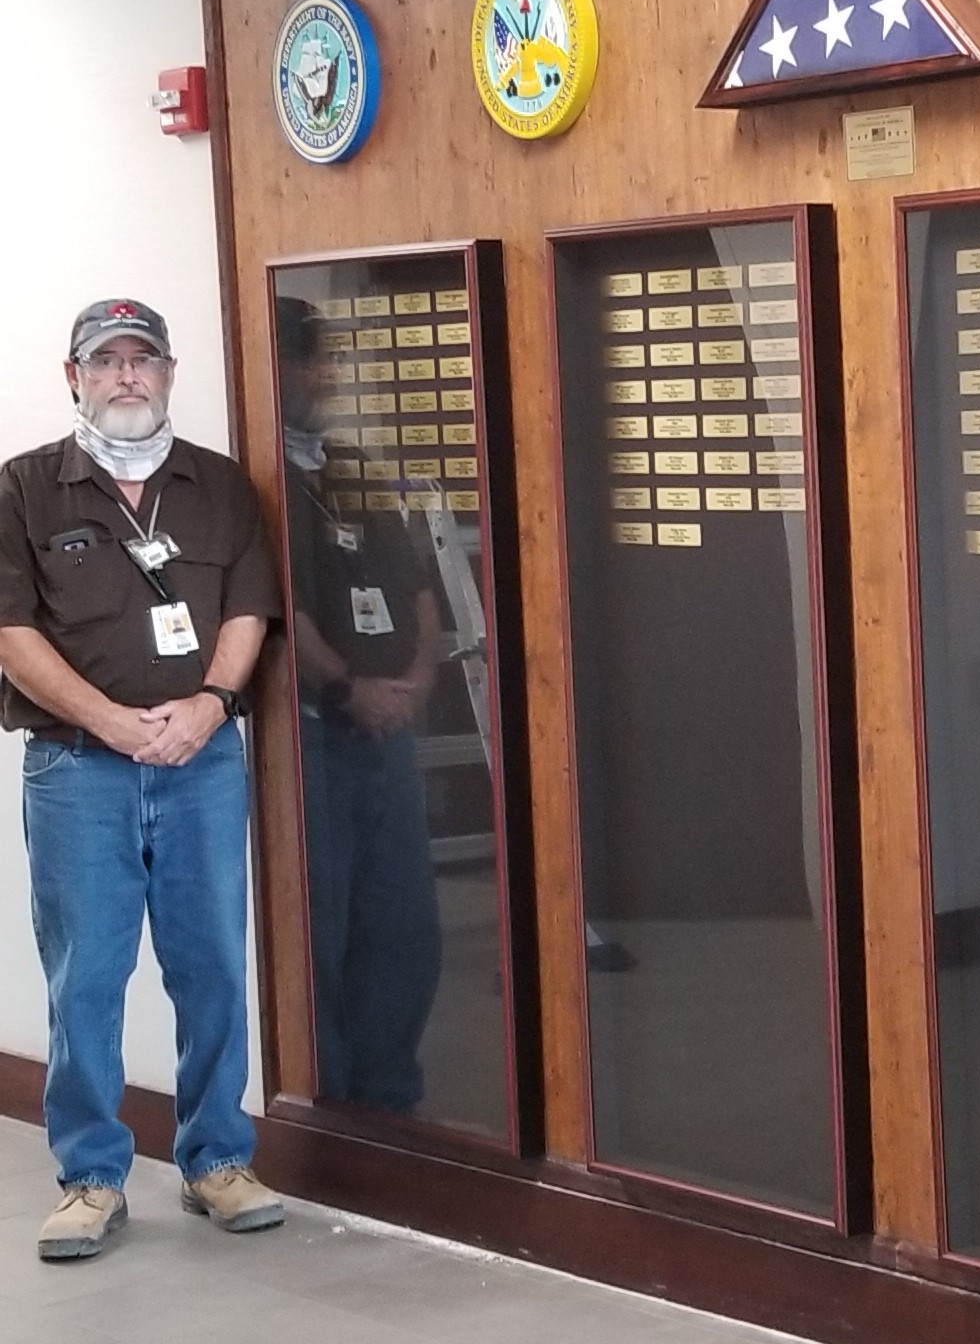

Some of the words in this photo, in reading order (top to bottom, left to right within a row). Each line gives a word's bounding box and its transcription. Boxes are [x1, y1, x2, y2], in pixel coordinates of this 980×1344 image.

[281, 7, 316, 69] DEPARTMENT
[316, 7, 327, 20] OF
[327, 11, 341, 31] THE
[502, 113, 539, 132] STATES
